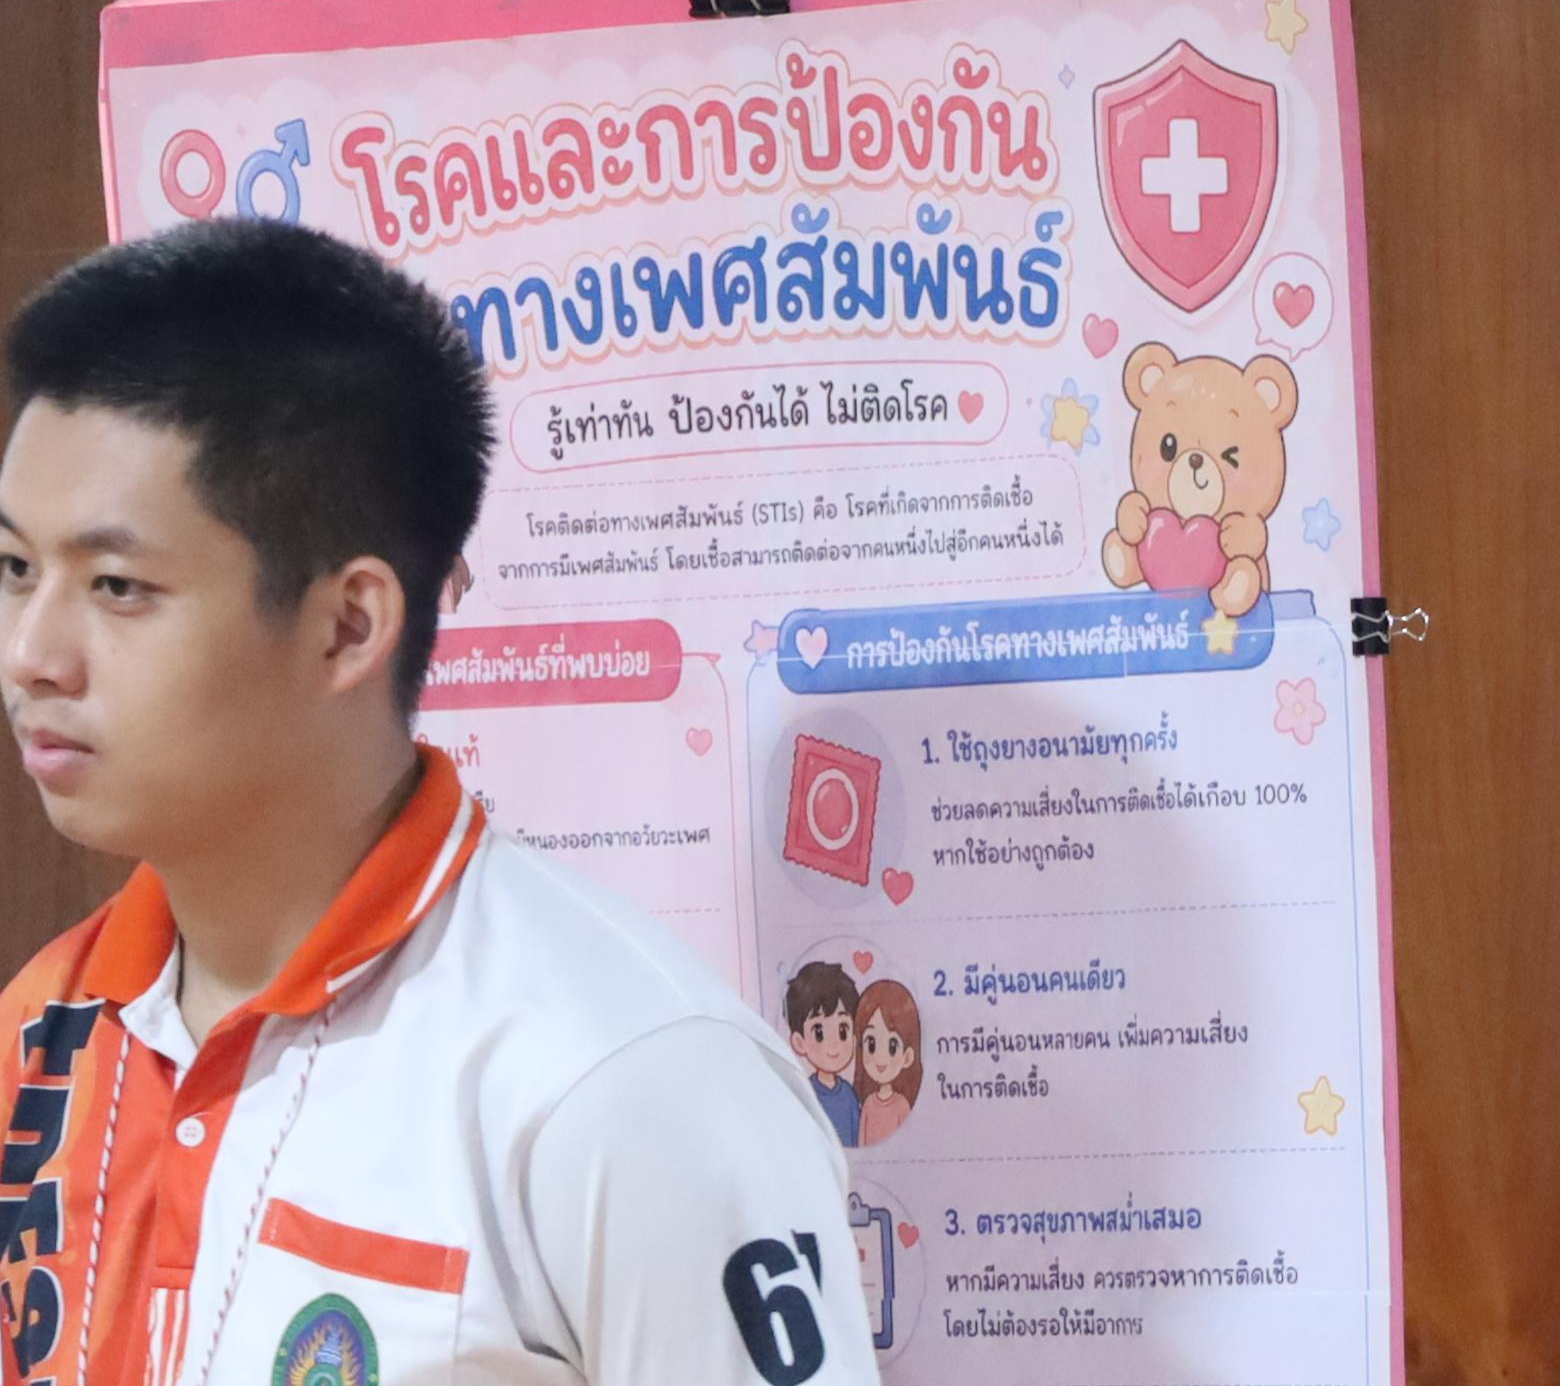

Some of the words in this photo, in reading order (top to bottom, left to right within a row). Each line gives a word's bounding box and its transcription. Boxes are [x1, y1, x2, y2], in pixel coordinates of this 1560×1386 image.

[341, 51, 1049, 246] โรคและการป้องกัน
[451, 202, 1066, 363] ทางเพศสัมพันธ์
[547, 395, 654, 460] รู้เท่าทัน
[669, 385, 810, 436] ป้องกันได้
[821, 380, 949, 425] ไม่ติดโรค
[526, 501, 746, 539] โรคติดต่อทางเพศสัมพันธ์
[752, 498, 806, 528] (STIs)
[814, 496, 839, 522] คือ
[846, 475, 1034, 519] โรคที่เกิดจากการติดเชื้อ
[498, 545, 660, 583] จากการมีเพศสัมพันธ์
[425, 632, 650, 688] เพศสัมพันธ์ที่พบบ่อย
[846, 610, 1190, 670] การป้องกันโรคทางเพศสัมพันธ์
[922, 736, 941, 765] 1.
[948, 712, 1178, 772] ใช้ถุงยางอนามัยทุกครั้ง
[931, 780, 1247, 824] ช่วยลดความเสี่ยงในการติดเชื้อได้เกือบ
[1254, 782, 1309, 807] 100%
[516, 826, 710, 853] ีหนองออกจากอวัยวะเพศ
[932, 839, 1094, 873] หากใช้อย่างถูกต้อง
[933, 969, 954, 997] 2.
[963, 959, 1127, 1006] มีคู่นอนคนเดียว
[936, 1024, 1111, 1065] การมีคู่นอนหลายคน
[1117, 1011, 1249, 1053] เพิ่มความเสี่ยง
[937, 1065, 1050, 1103] ในการติดเชื้อ
[945, 1208, 967, 1237] 3.
[976, 1193, 1203, 1245] ตรวจสุขภาพสม่ำเสมอ
[945, 1259, 1086, 1297] หากมีความเสี่ยง
[1092, 1250, 1300, 1293] ควรตรวจหาการติดเชื้อ
[944, 1306, 1144, 1341] โดยไม่ต้องรอให้มีอาการ
